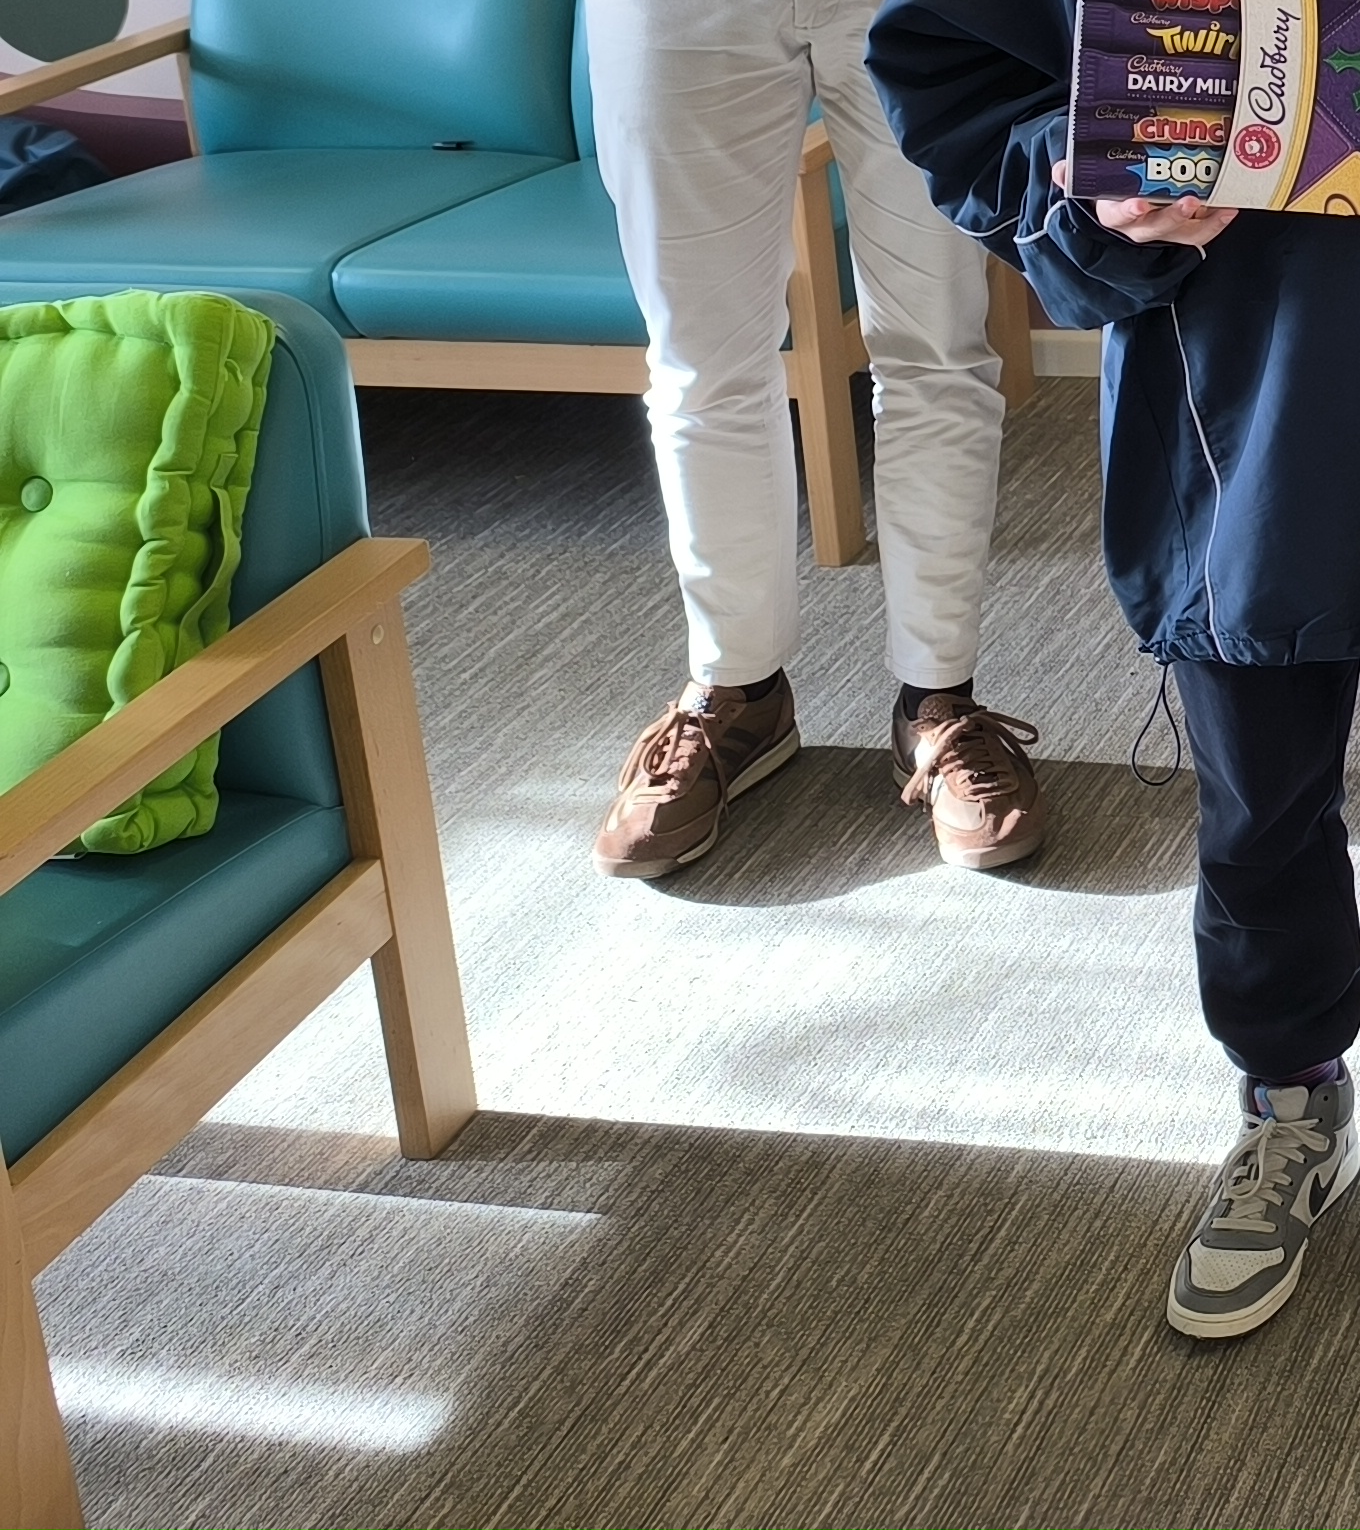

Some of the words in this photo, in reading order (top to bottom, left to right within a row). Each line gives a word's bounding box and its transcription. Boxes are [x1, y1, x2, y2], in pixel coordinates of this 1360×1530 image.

[1131, 11, 1170, 26] Cadbury
[1127, 54, 1183, 76] Cadbury
[1248, 8, 1301, 125] Cadbury
[1127, 73, 1194, 93] DAIRY
[1196, 78, 1237, 96] MIL
[1095, 105, 1139, 120] Cadbury
[1107, 147, 1147, 161] Cadbury
